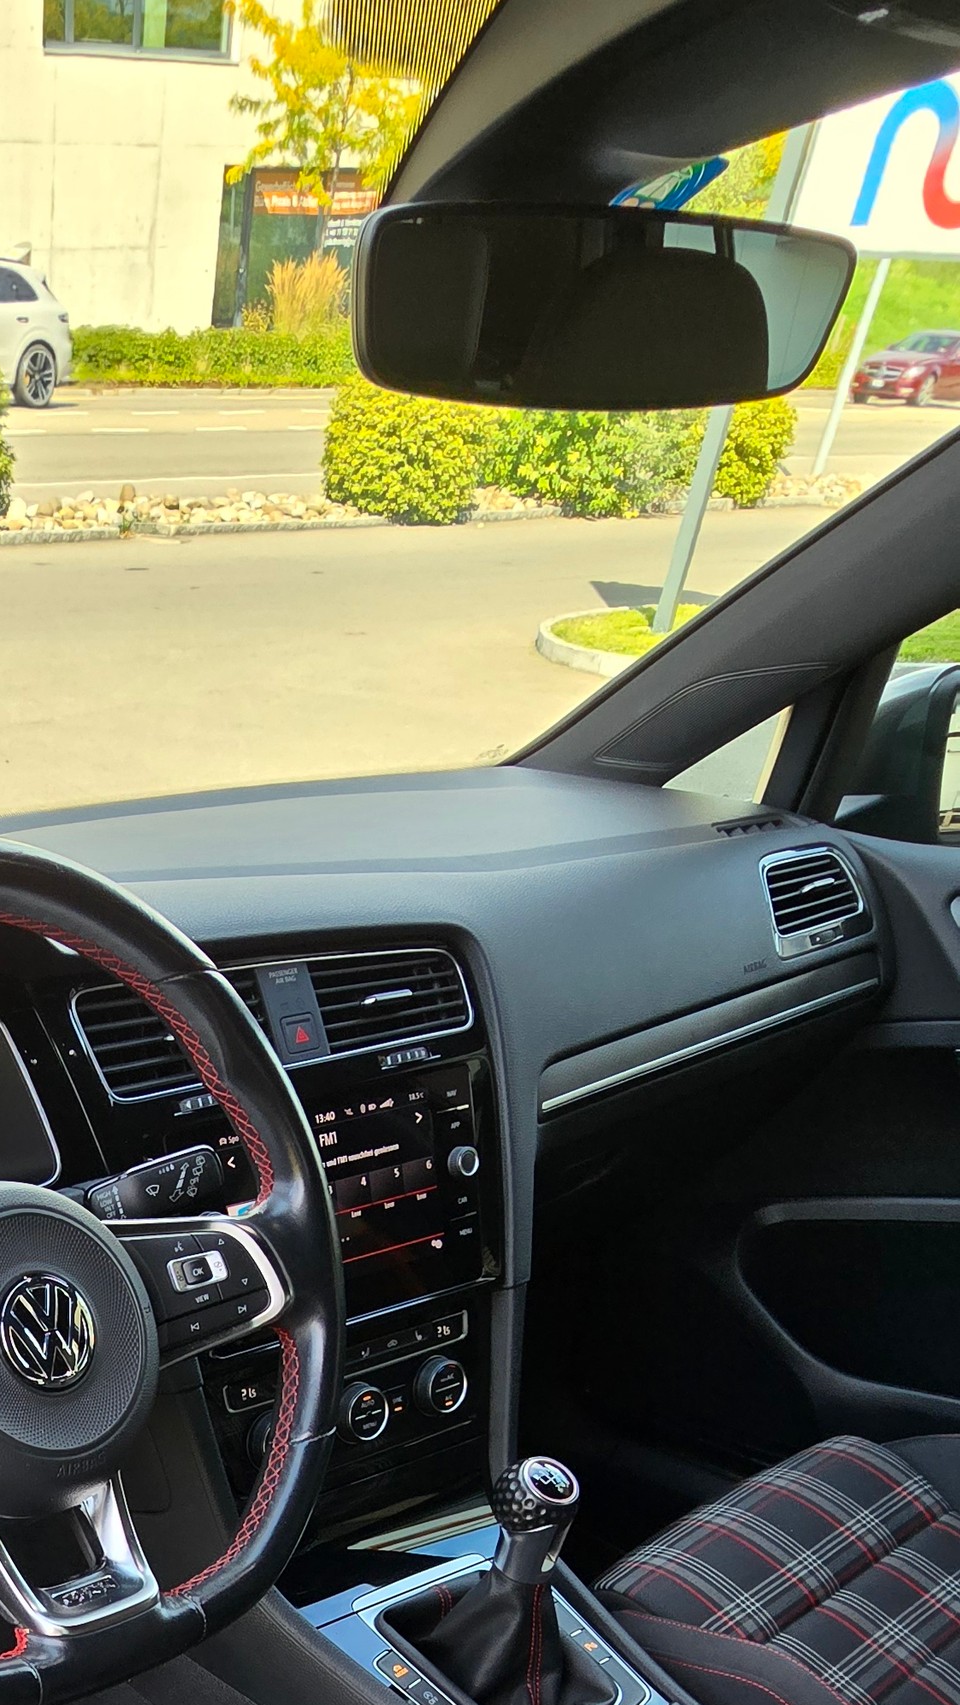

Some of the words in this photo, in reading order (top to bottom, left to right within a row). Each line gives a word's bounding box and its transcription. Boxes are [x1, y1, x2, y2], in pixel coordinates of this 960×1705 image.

[268, 967, 298, 979] PASSENGER
[315, 1111, 336, 1124] 13:40
[228, 1135, 240, 1145] Spo
[319, 1131, 338, 1148] FM1
[425, 1159, 433, 1170] 6
[393, 1168, 400, 1178] 5
[360, 1176, 367, 1187] 4
[457, 1196, 468, 1204] CAR
[193, 1266, 205, 1276] OK
[195, 1293, 210, 1303] VIEW
